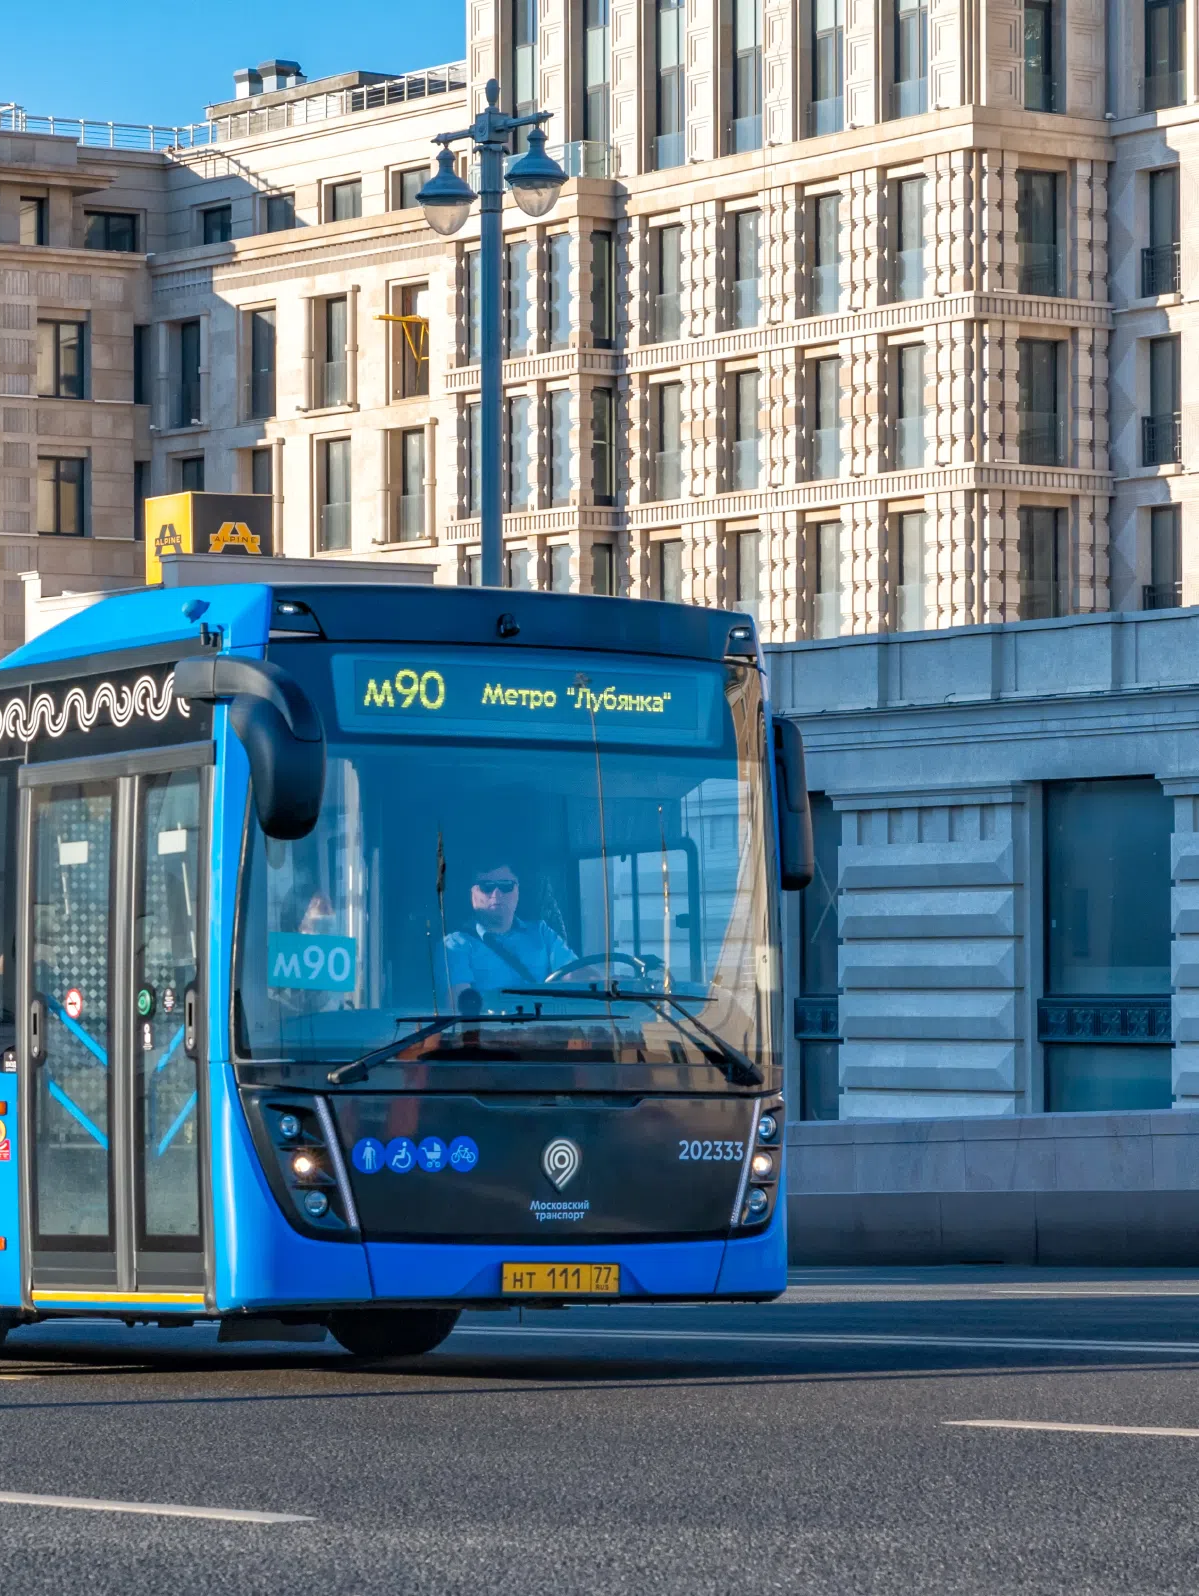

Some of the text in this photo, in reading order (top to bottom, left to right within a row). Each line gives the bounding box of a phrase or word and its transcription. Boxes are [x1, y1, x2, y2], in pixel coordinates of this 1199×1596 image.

[155, 536, 181, 546] ALPINE
[482, 683, 557, 710] Метро
[567, 687, 671, 713] "Лубянка"
[679, 1140, 744, 1160] 202333
[530, 1200, 589, 1210] Московский
[535, 1212, 584, 1221] транспорт
[513, 1266, 611, 1289] НТ 111 77
